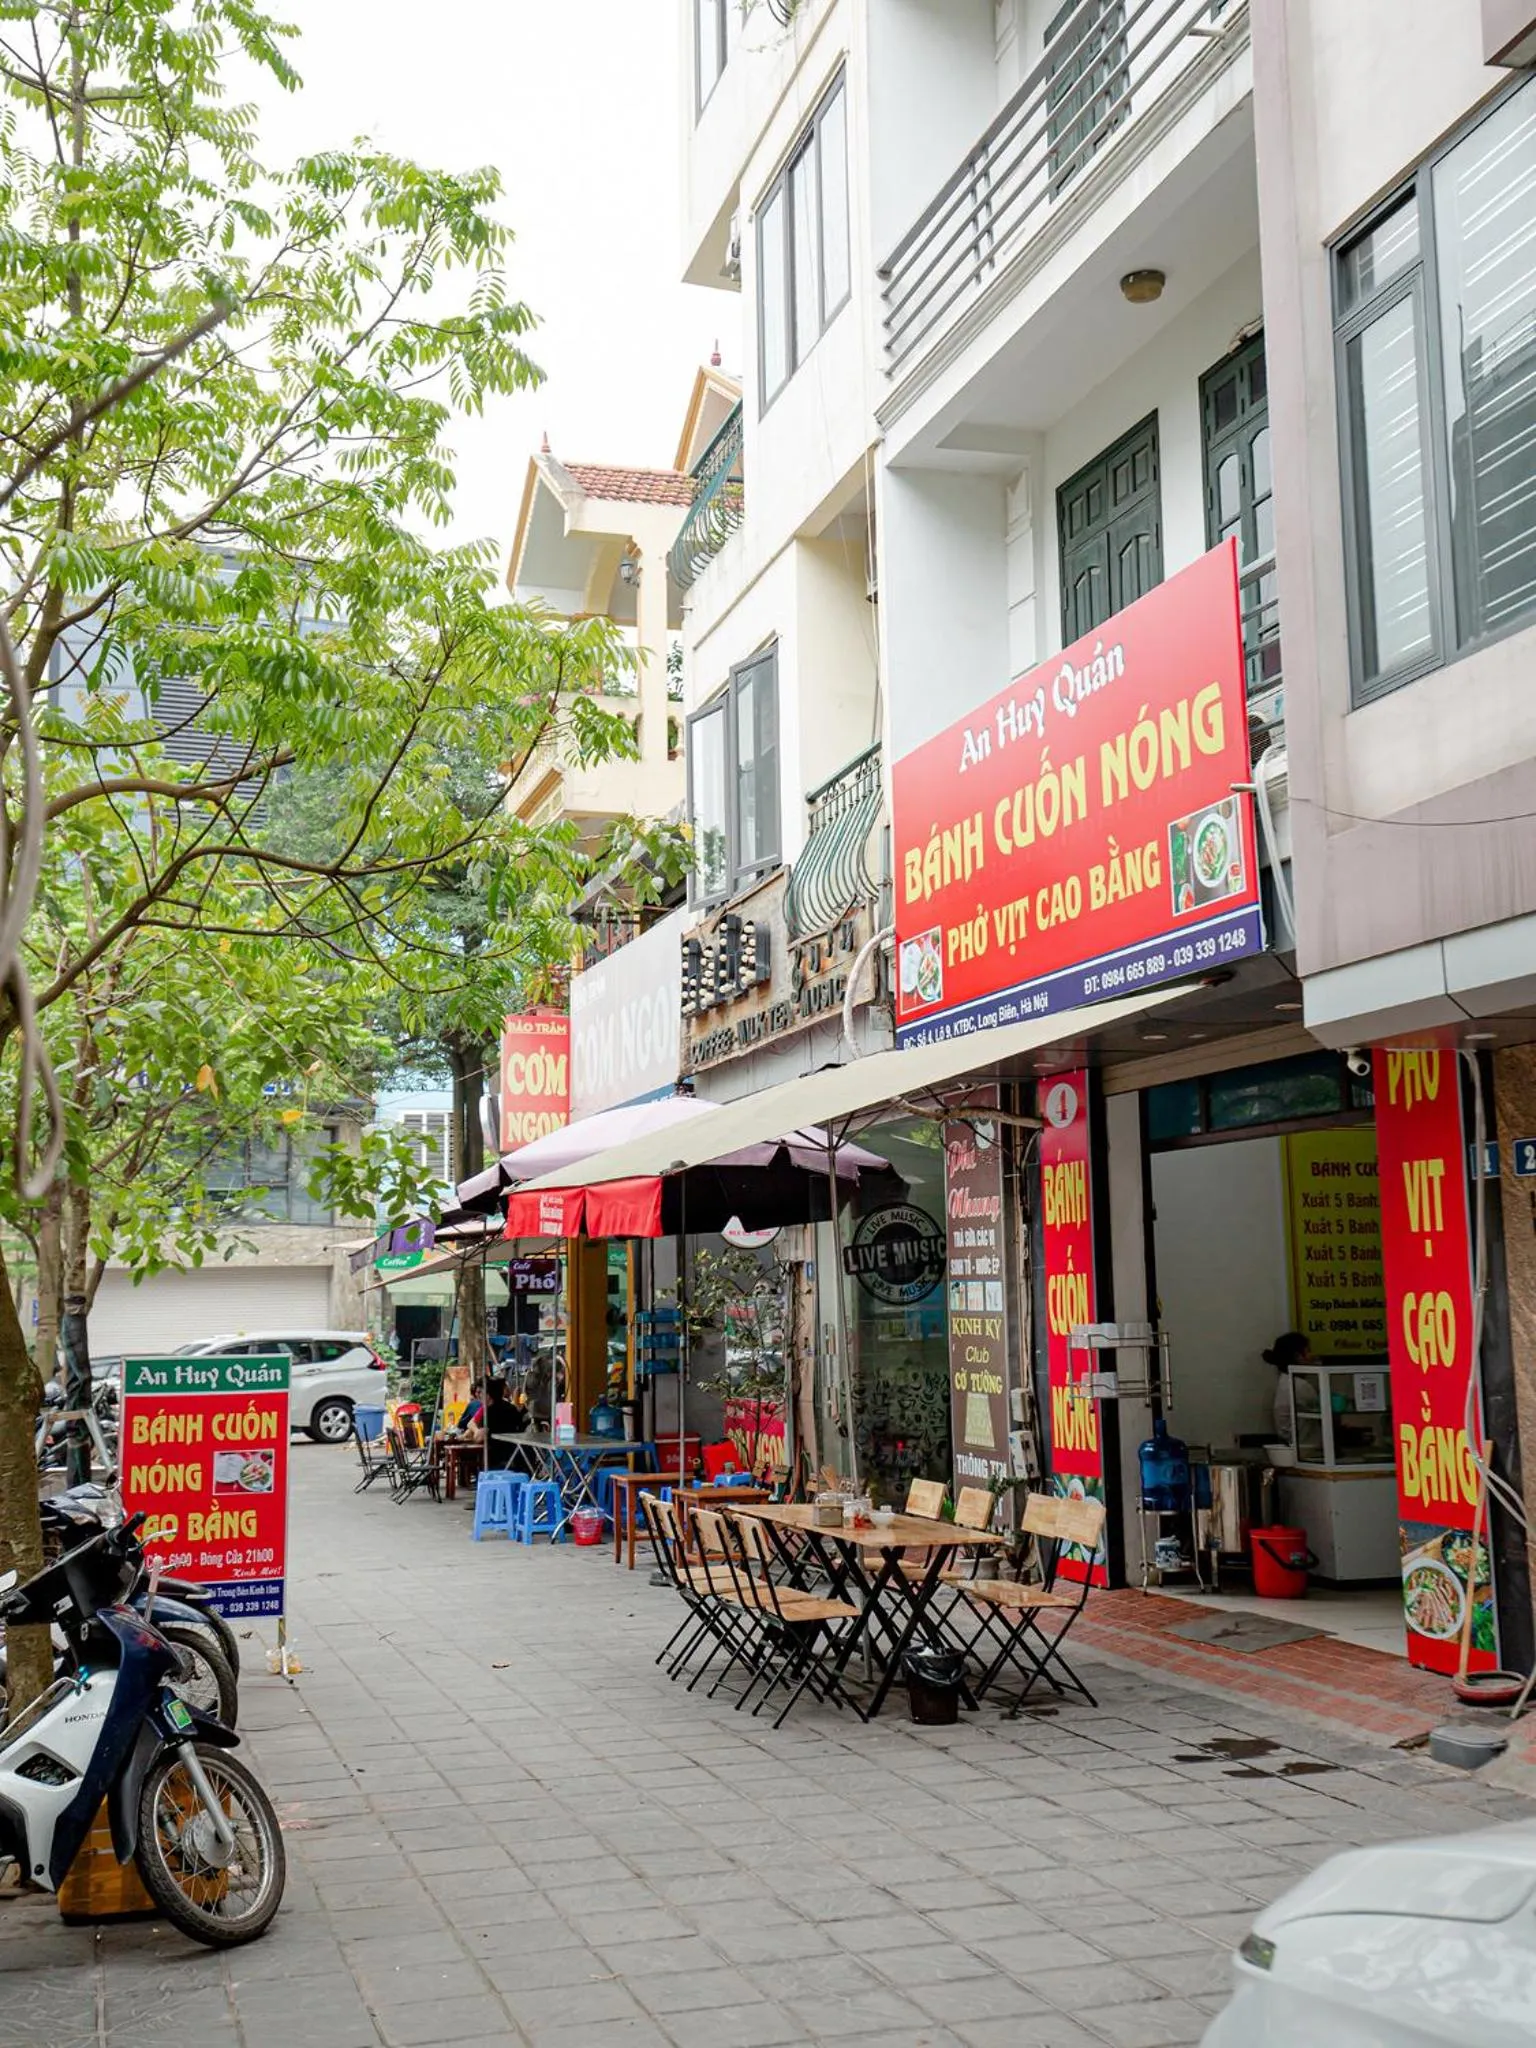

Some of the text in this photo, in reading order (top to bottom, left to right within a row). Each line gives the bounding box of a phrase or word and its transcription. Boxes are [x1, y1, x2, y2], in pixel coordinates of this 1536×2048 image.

[959, 640, 1125, 774] An Huy Quán
[904, 681, 1226, 906] BÁNH CUỐN NÓNG
[946, 834, 1163, 968] PHỞ VỊT CAO BẰNG
[1101, 966, 1125, 990] 0984
[1126, 960, 1145, 982] 665
[1146, 954, 1166, 976] 889
[1173, 946, 1194, 967] 039
[1195, 937, 1216, 961] 339
[1217, 927, 1247, 953] 1248
[977, 1011, 998, 1031] Long
[1020, 996, 1033, 1016] Hà
[1033, 990, 1049, 1013] Nội
[506, 1044, 568, 1097] CƠM
[1044, 1148, 1088, 1232] BÁNH
[867, 1211, 924, 1235] LIVE MUSIC
[847, 1238, 947, 1272] LIVE MUSIC
[965, 1345, 990, 1365] Club
[1402, 1290, 1457, 1375] CAO
[135, 1363, 283, 1389] An Huy Quán
[131, 1400, 279, 1447] BÁNH CUỐN
[129, 1458, 203, 1494] NÓNG
[132, 1498, 258, 1544] AO BẰNG
